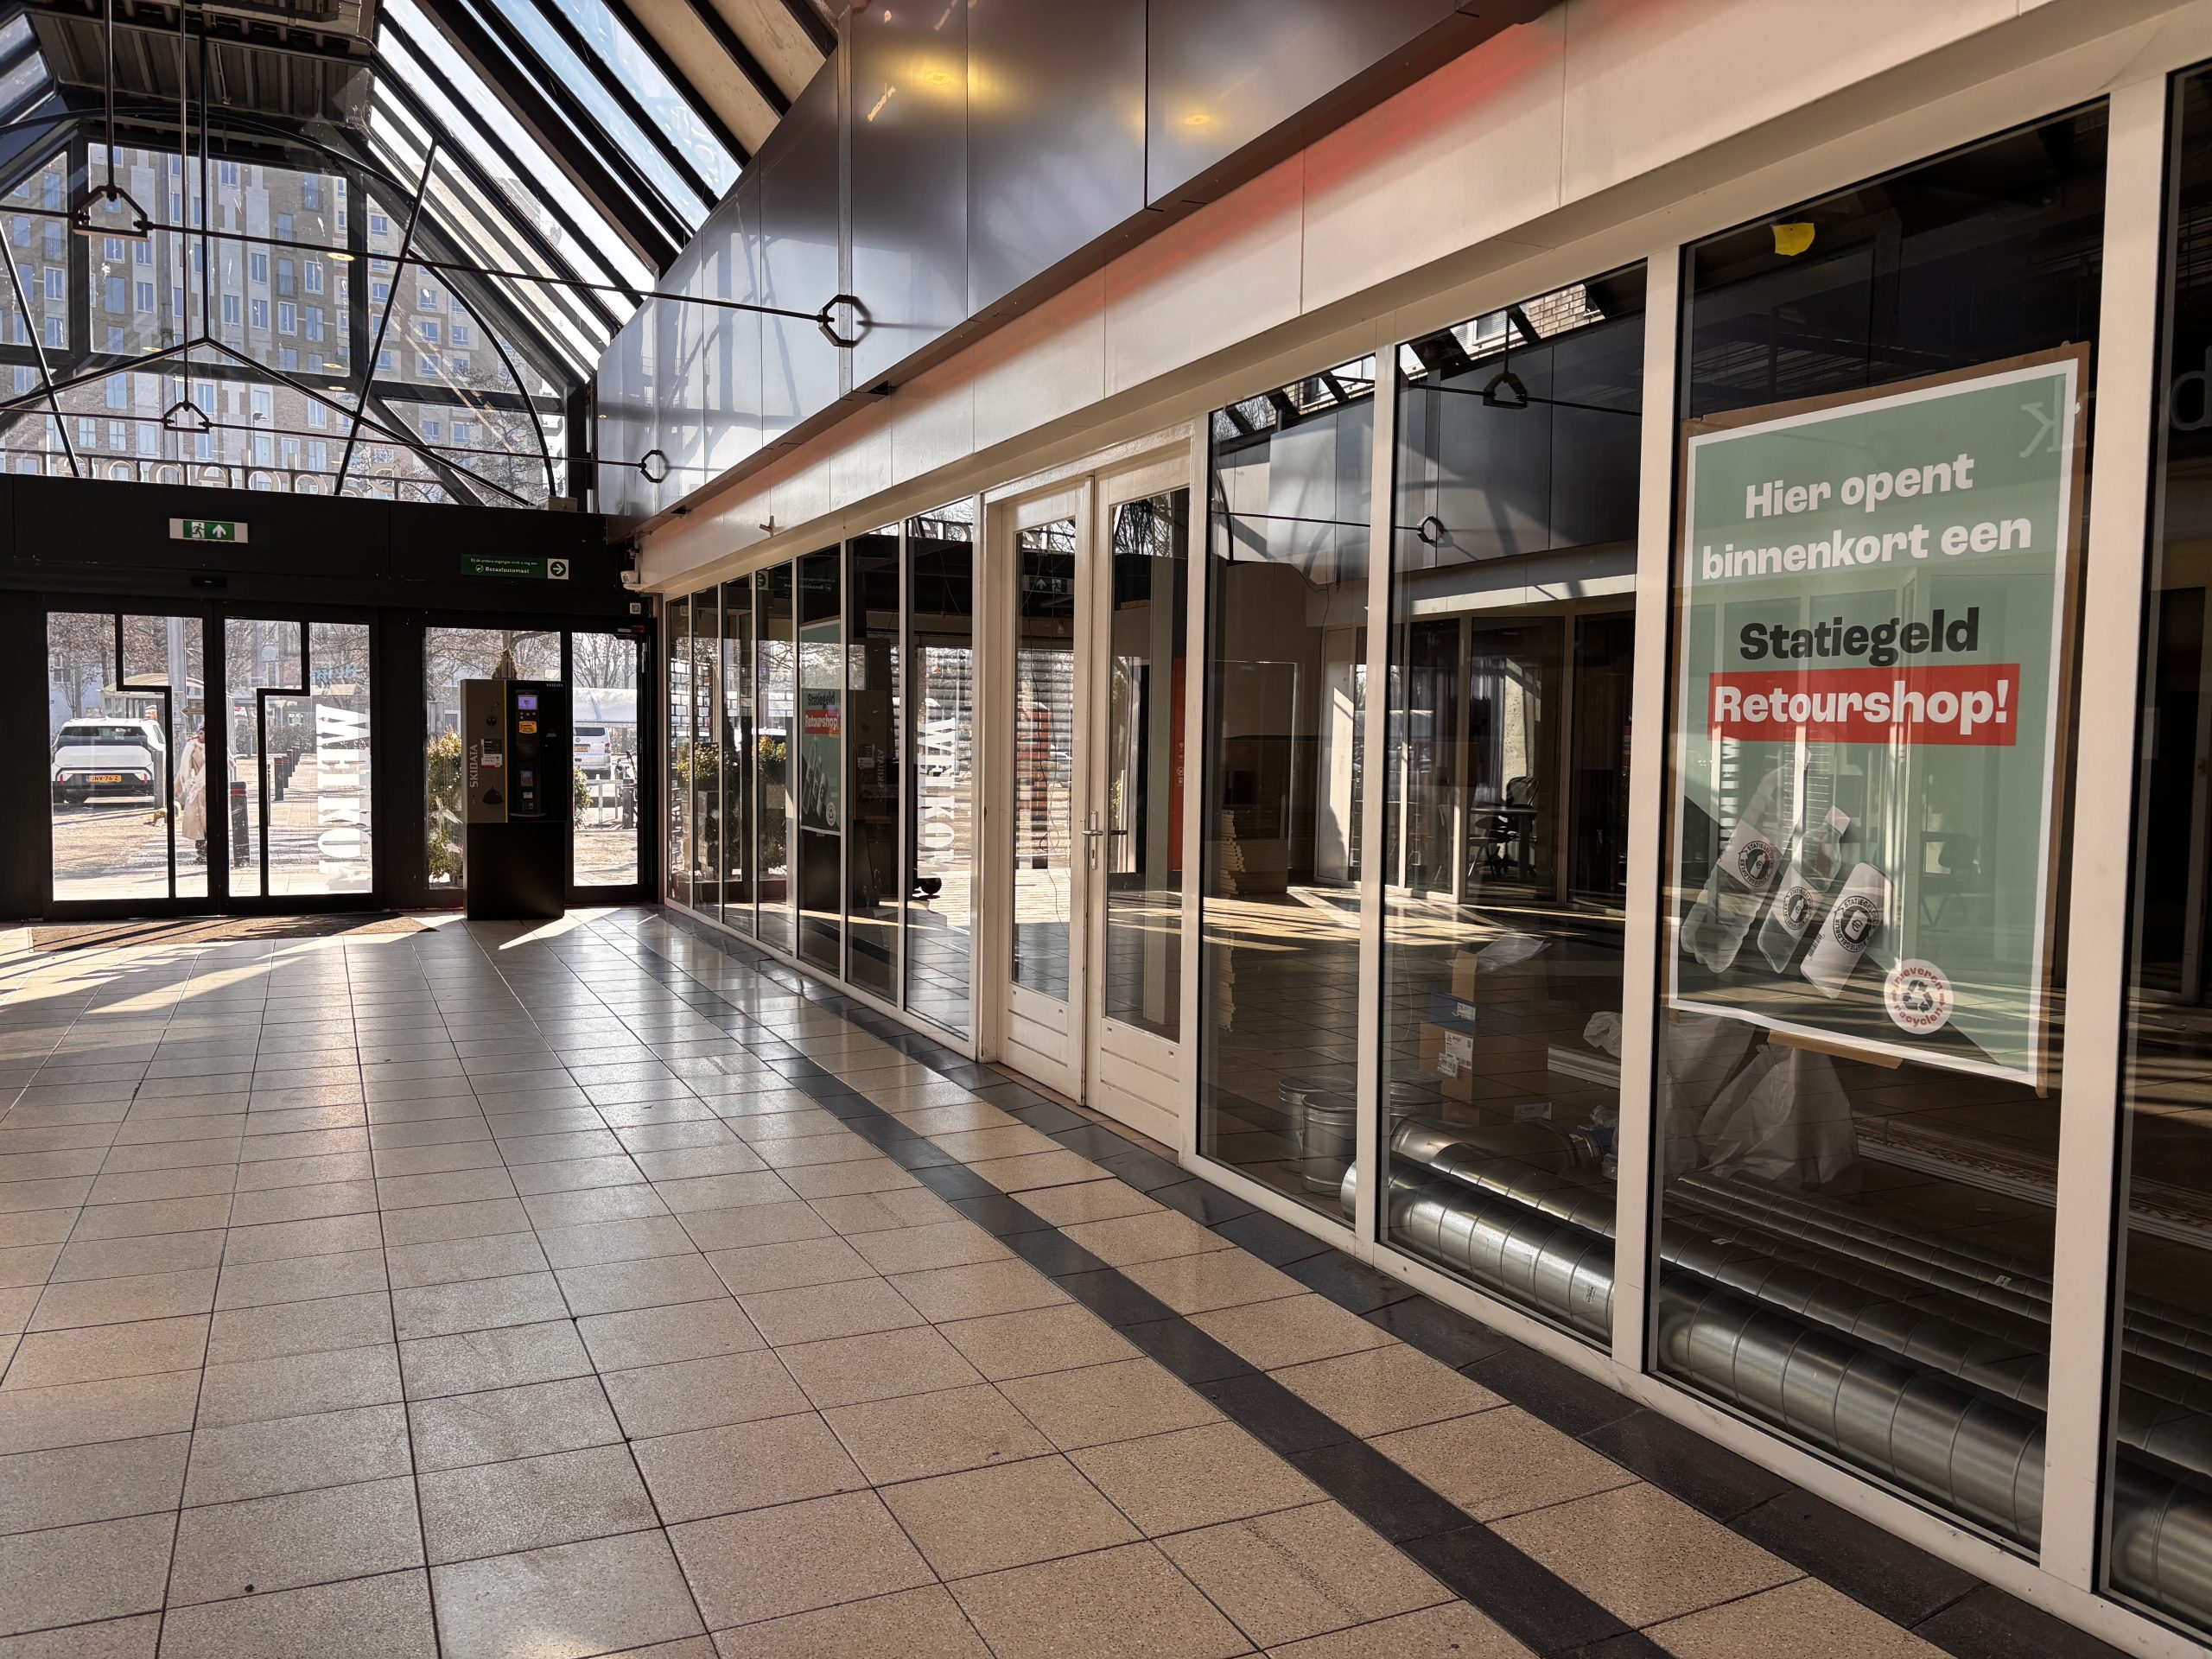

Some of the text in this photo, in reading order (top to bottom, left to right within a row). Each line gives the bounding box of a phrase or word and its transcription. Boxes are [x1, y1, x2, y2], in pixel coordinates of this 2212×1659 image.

[1745, 454, 1974, 518] Hier opent
[1702, 518, 2031, 580] binnenkort een
[1740, 607, 1980, 667] Statiegeld
[804, 714, 840, 729] Retourshop!
[808, 691, 836, 709] Statiegeld
[1714, 680, 2009, 734] Retourshop!
[469, 744, 479, 788] SKIDATA
[1894, 1005, 1943, 1027] recyclen
